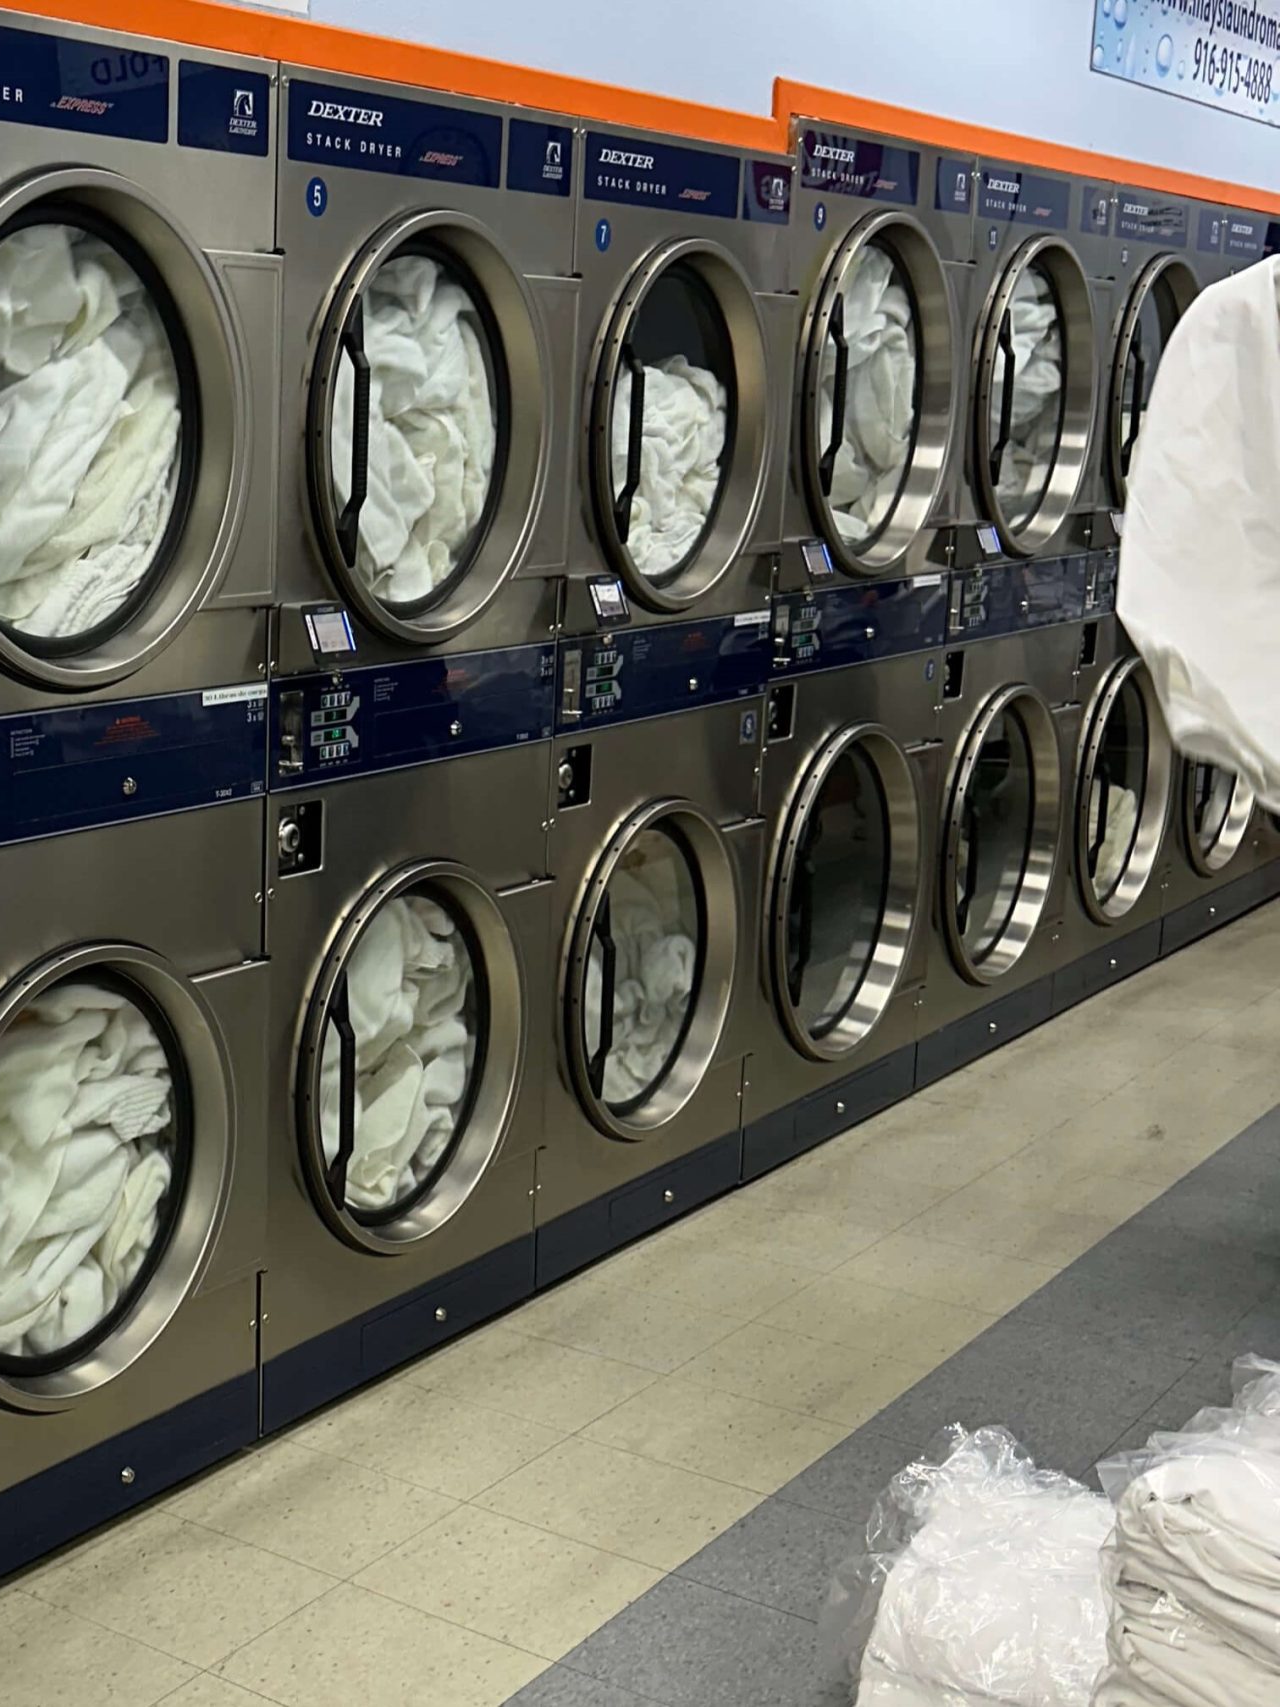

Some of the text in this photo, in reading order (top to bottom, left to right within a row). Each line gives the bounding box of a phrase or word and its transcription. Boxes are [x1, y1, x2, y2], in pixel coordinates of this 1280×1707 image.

[1150, 0, 1280, 51] .mayslaundrom
[1192, 37, 1273, 104] 916-915-4888
[56, 95, 108, 114] EXPRESS
[308, 101, 383, 127] DEXTER
[307, 132, 402, 158] STACK DRYER
[813, 144, 855, 163] DEXTER
[599, 149, 654, 170] DEXTER
[811, 167, 837, 181] STACK
[597, 175, 631, 190] STACK
[636, 181, 667, 195] DRYER
[987, 178, 1020, 194] DEXTER
[313, 185, 322, 207] 5
[600, 226, 607, 244] 7
